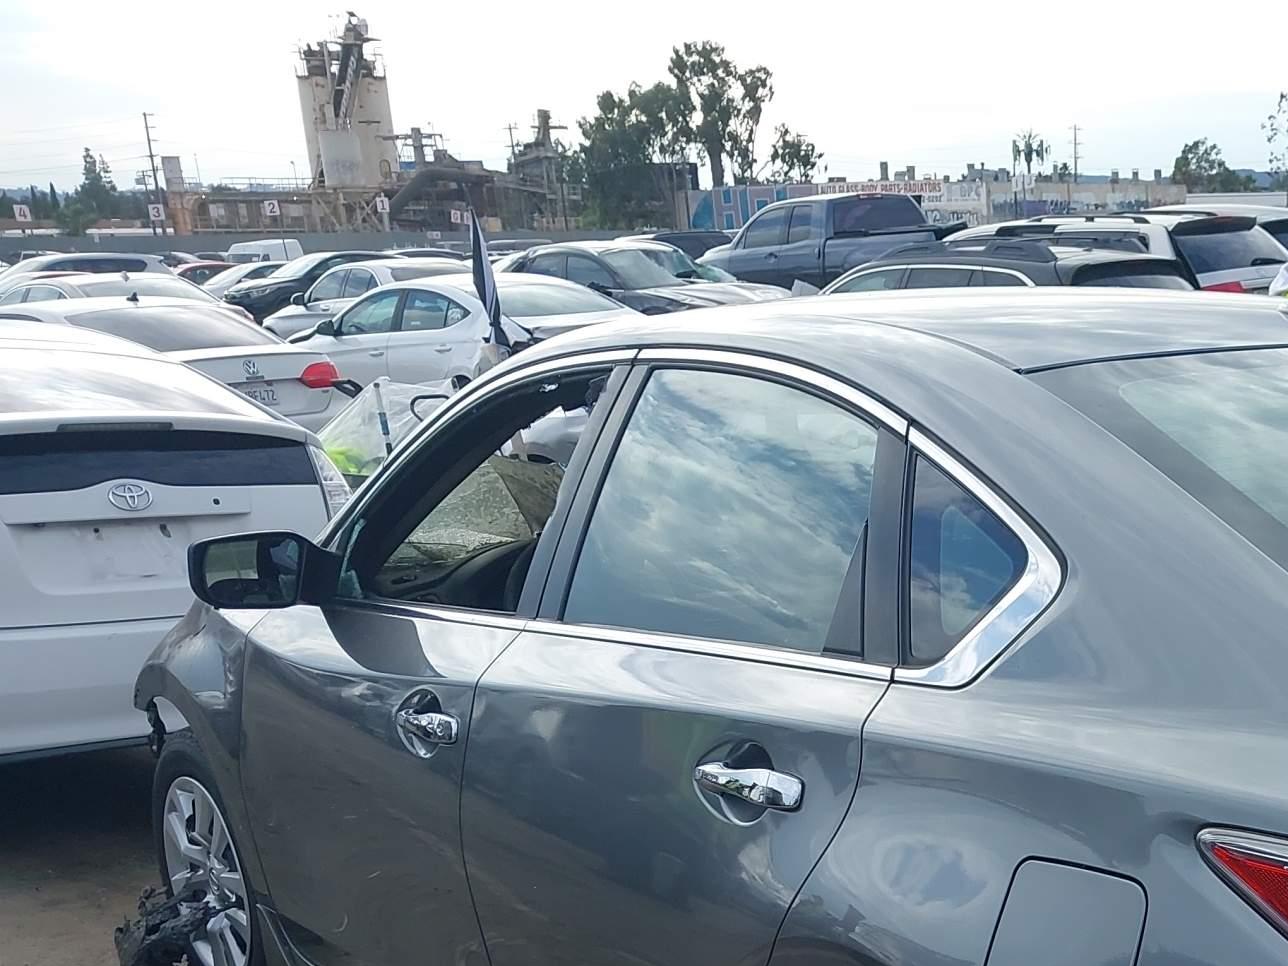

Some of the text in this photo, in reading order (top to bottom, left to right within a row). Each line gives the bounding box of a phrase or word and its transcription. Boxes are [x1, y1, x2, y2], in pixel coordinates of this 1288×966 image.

[267, 202, 277, 214] 2
[379, 199, 387, 211] 1
[18, 208, 27, 219] 4
[152, 206, 161, 218] 3
